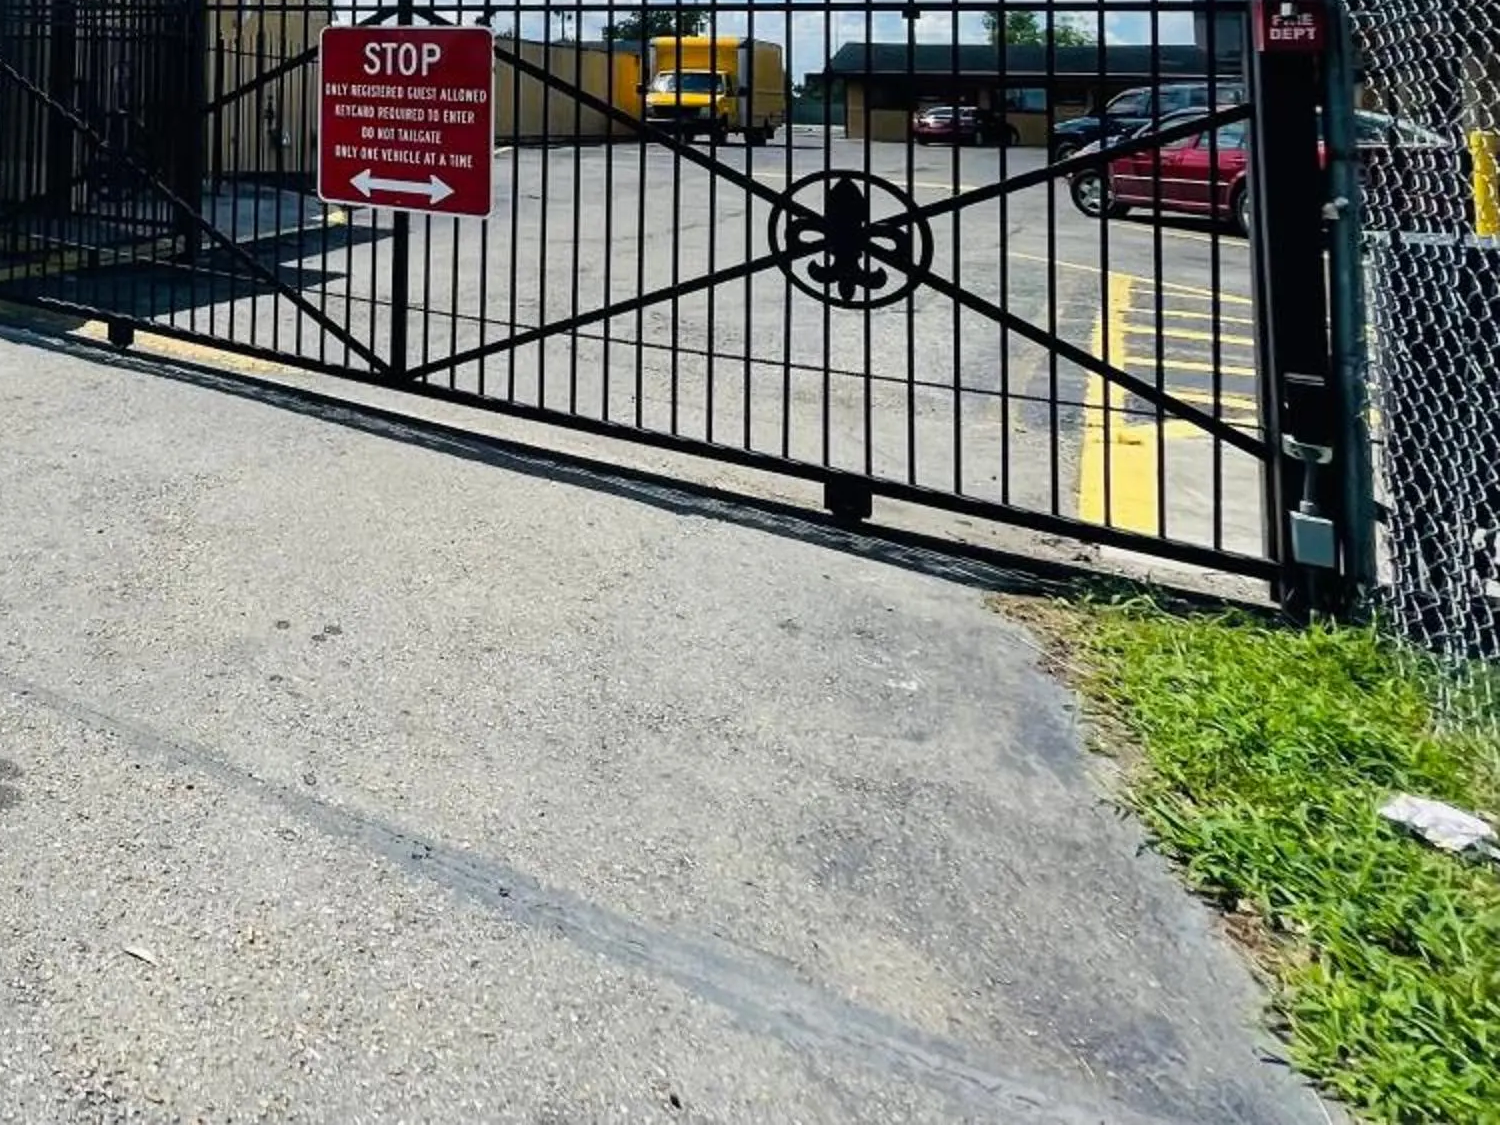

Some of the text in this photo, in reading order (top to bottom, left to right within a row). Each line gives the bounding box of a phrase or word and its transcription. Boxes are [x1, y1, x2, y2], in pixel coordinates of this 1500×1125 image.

[1270, 27, 1316, 40] DEPT
[363, 42, 441, 76] STOP
[325, 83, 487, 103] ONLY REGISTERED GUEST ALLOWED
[335, 104, 475, 124] KEYCARD REQUIRED TO ENTER
[361, 126, 442, 144] DO NOT TAILGATE
[335, 144, 473, 168] ONLY ONE VEHICLE AT A TIME
